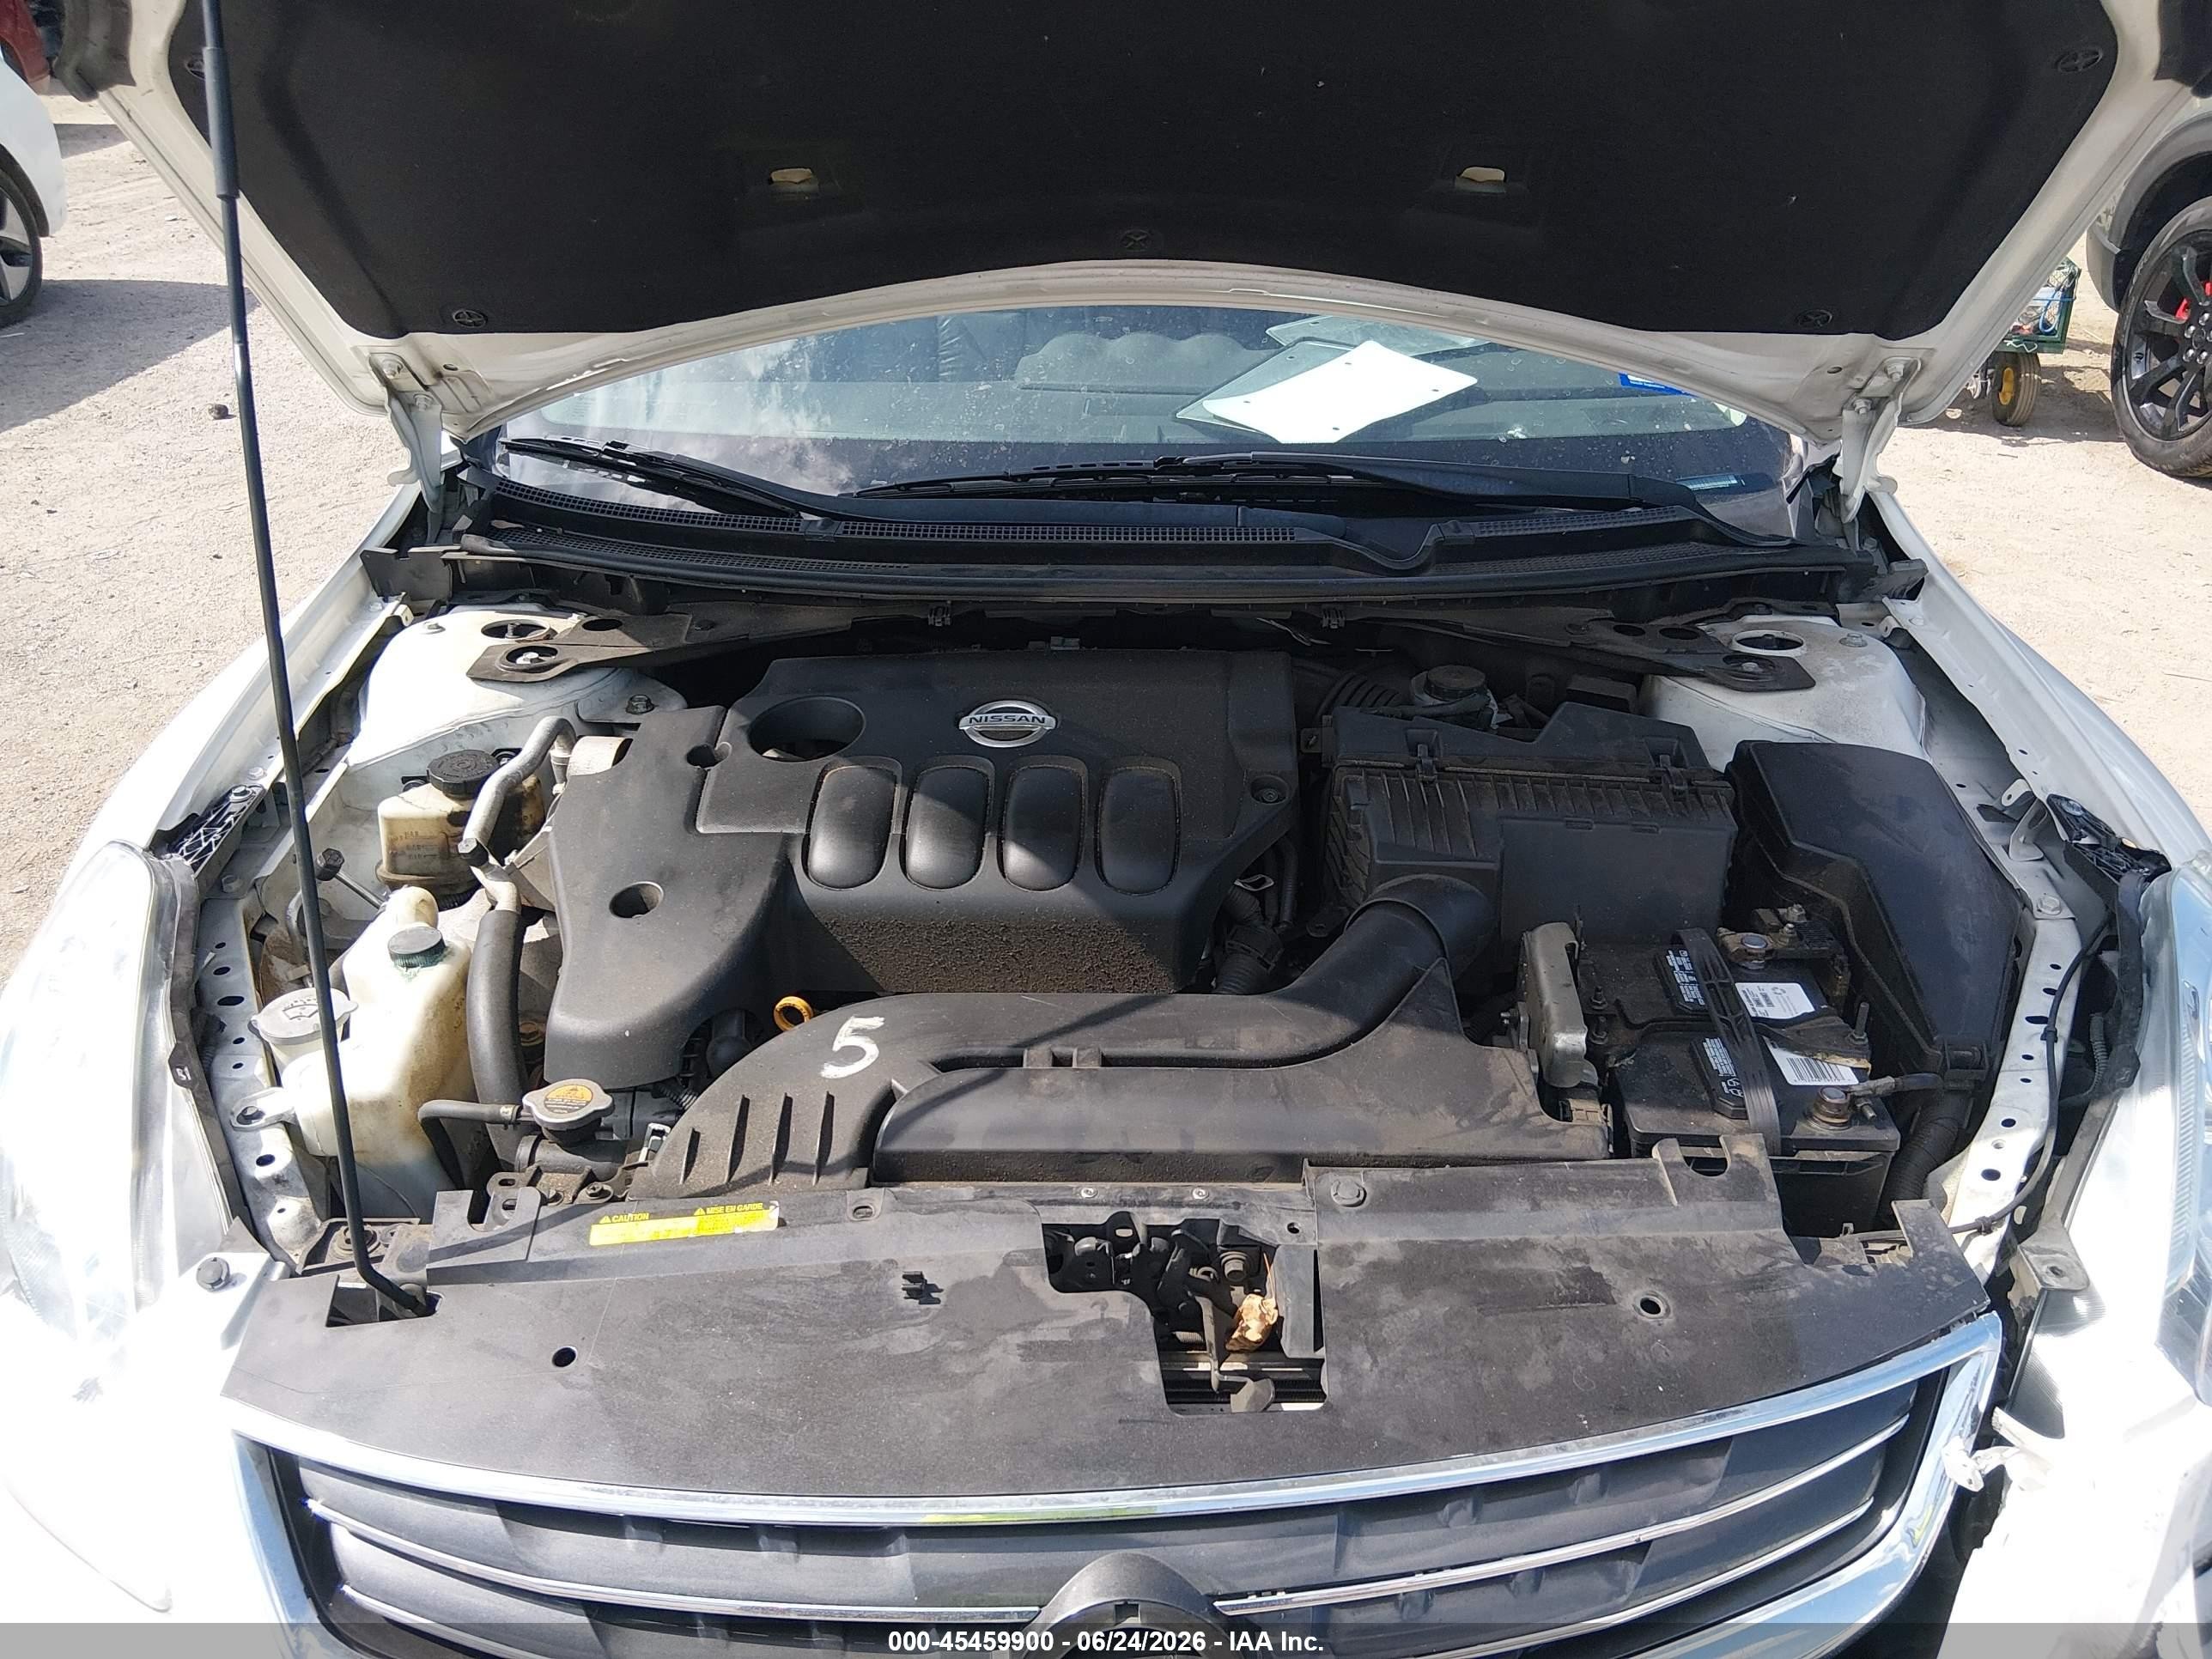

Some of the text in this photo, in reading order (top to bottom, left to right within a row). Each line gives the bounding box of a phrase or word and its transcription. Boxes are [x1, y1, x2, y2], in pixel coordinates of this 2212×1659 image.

[969, 714, 1046, 724] NISSAN
[819, 1015, 885, 1079] 5
[706, 1202, 763, 1214] MISE EN GARDE
[611, 1212, 650, 1223] CAUTION
